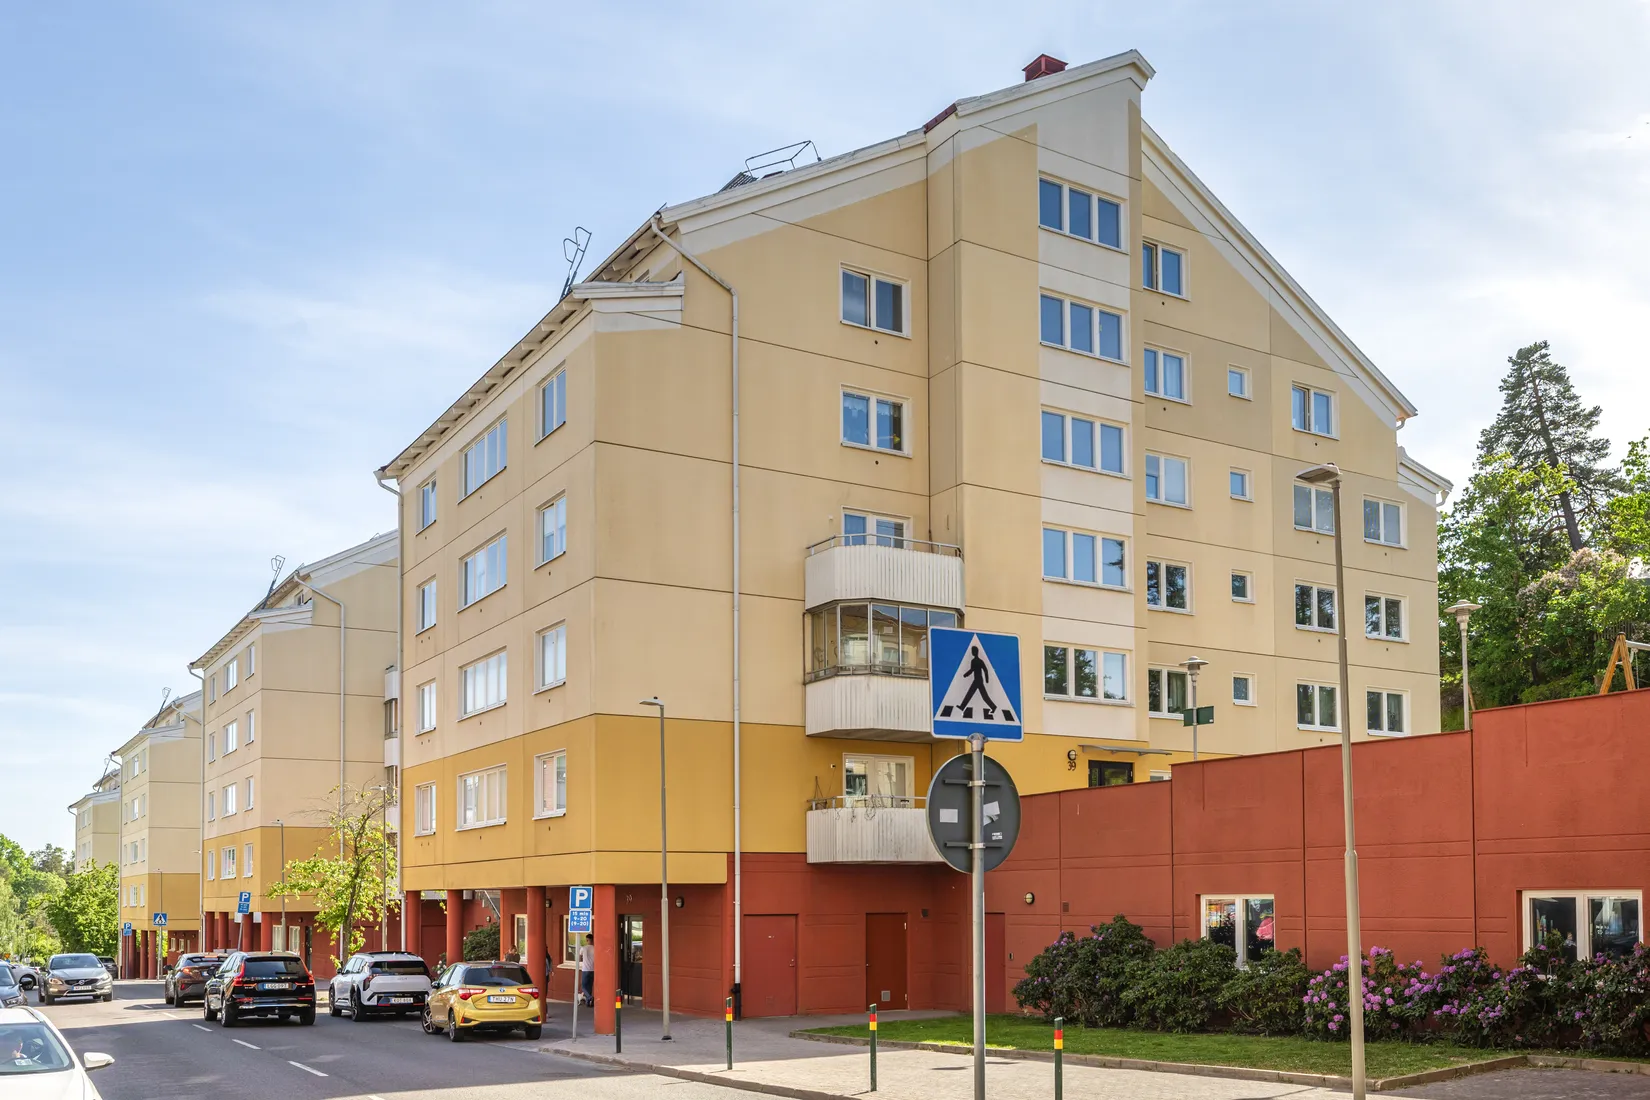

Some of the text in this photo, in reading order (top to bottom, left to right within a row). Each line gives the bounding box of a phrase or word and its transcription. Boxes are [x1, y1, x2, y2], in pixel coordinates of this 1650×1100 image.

[1067, 761, 1077, 771] 39
[241, 892, 249, 902] P
[575, 889, 589, 907] P
